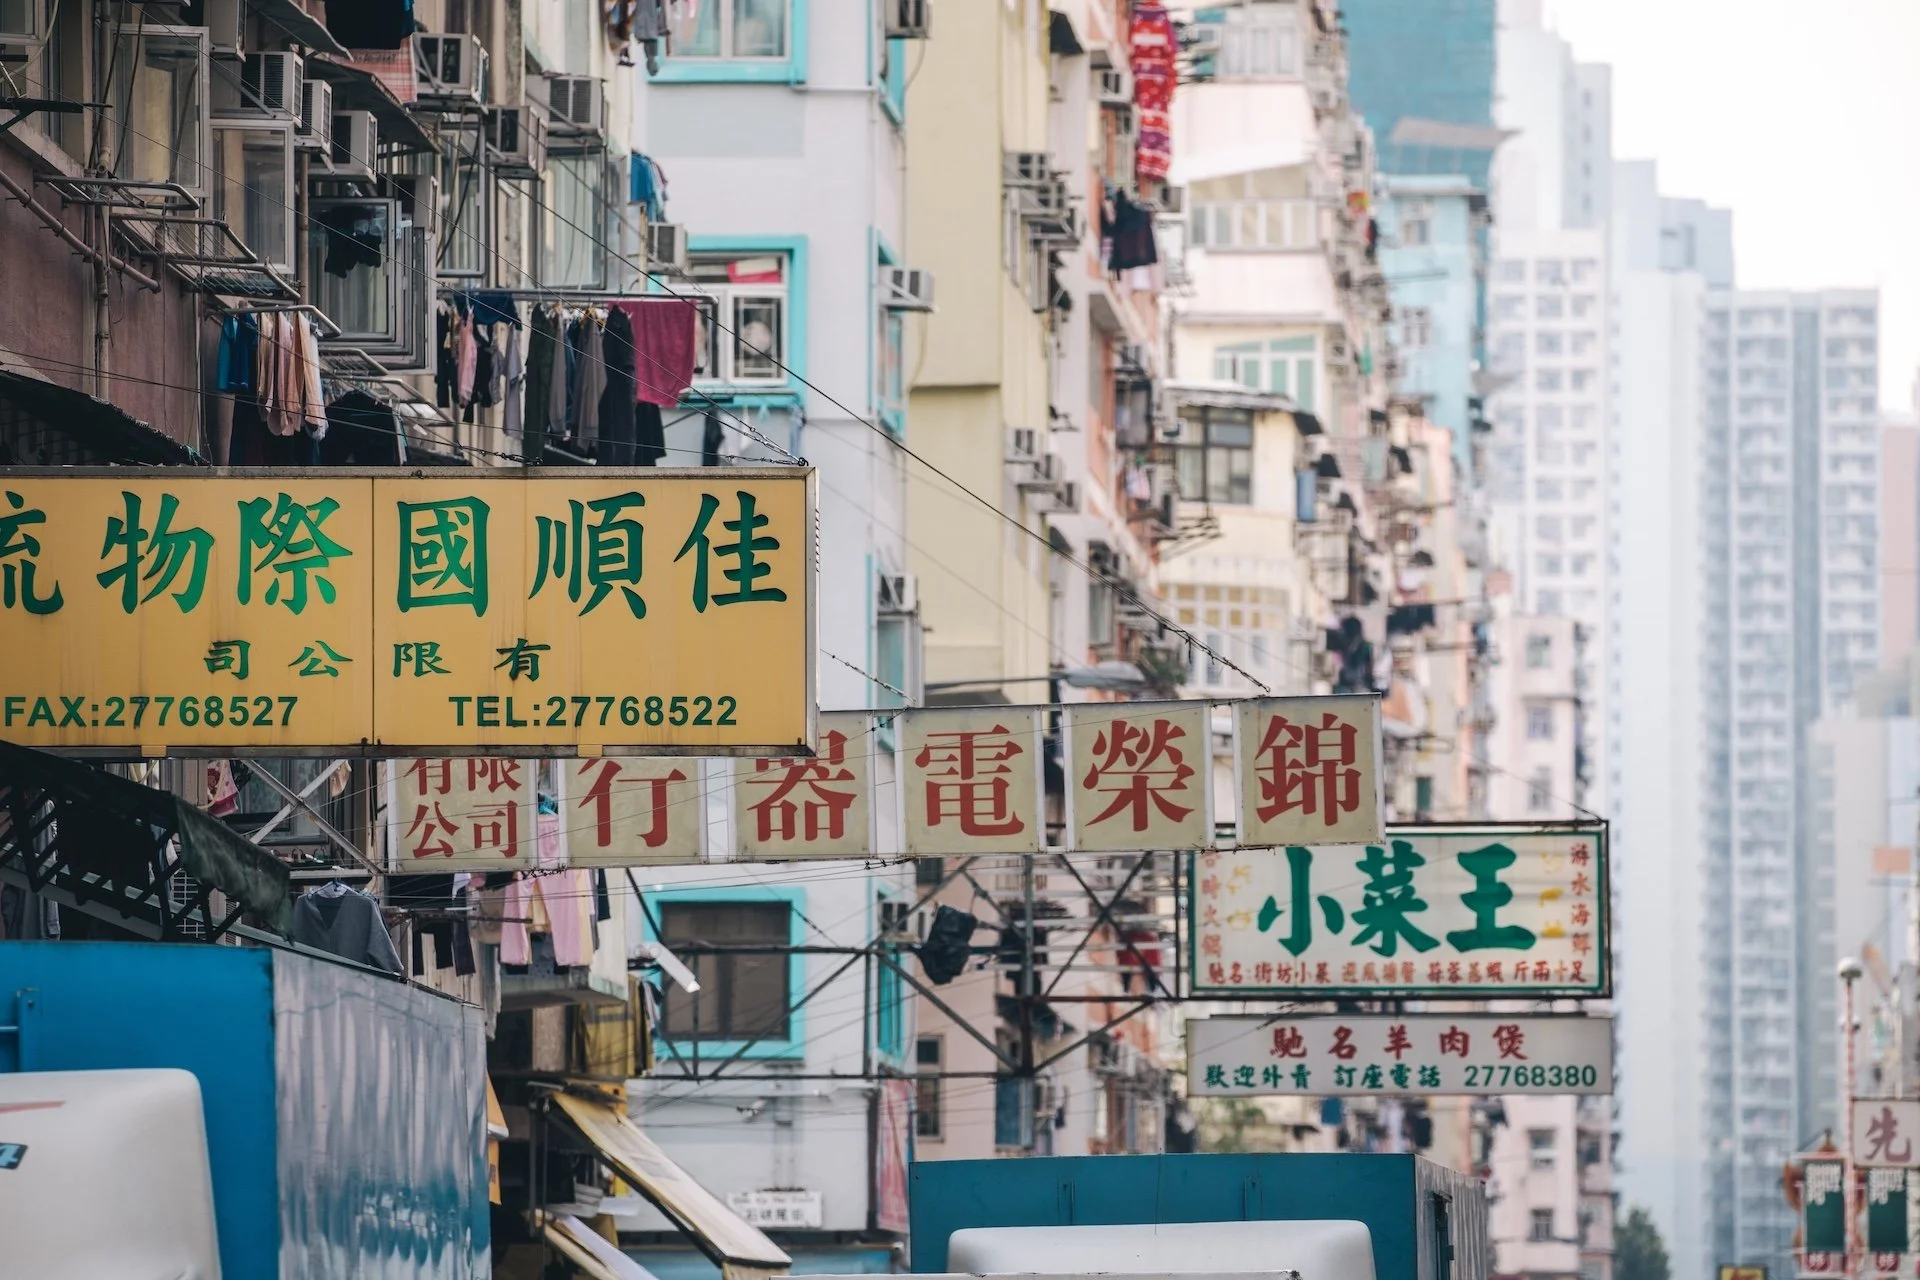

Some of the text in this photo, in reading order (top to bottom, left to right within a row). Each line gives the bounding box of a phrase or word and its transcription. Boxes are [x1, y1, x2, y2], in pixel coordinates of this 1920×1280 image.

[5, 696, 297, 727] FAX:27768527
[450, 696, 737, 726] TEL:27768522
[1258, 840, 1536, 958] 小菜王
[1269, 1024, 1529, 1060] 馳名羊肉煲
[1464, 1064, 1598, 1088] 27768380
[1865, 1107, 1912, 1164] 先
